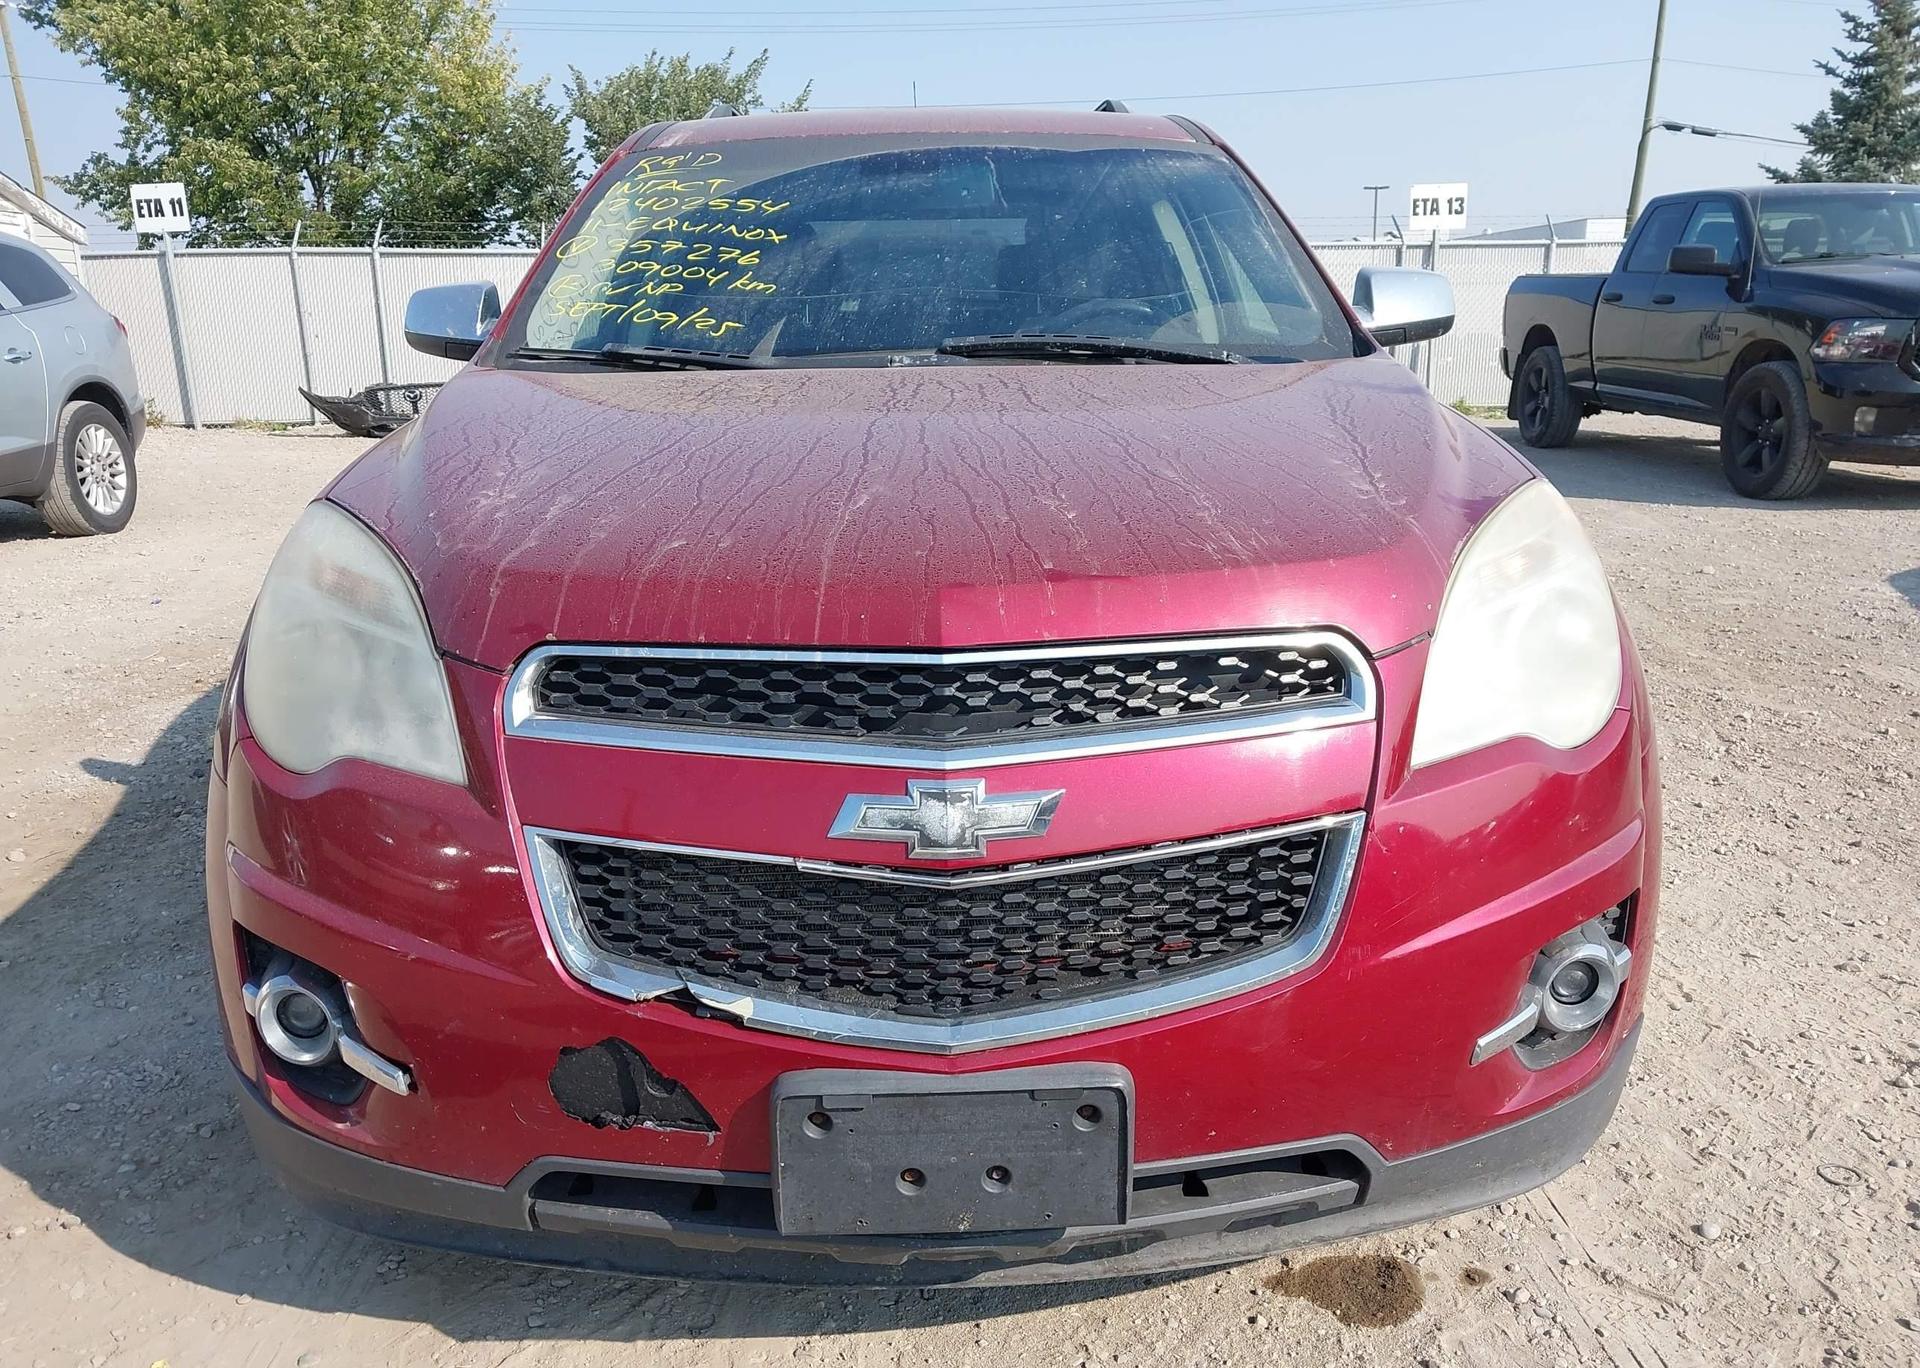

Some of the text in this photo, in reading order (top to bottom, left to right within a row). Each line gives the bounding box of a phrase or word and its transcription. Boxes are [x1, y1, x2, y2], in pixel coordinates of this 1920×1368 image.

[605, 178, 735, 200] INTACT
[136, 197, 184, 218] ETA 11
[1412, 197, 1465, 216] ETA 13
